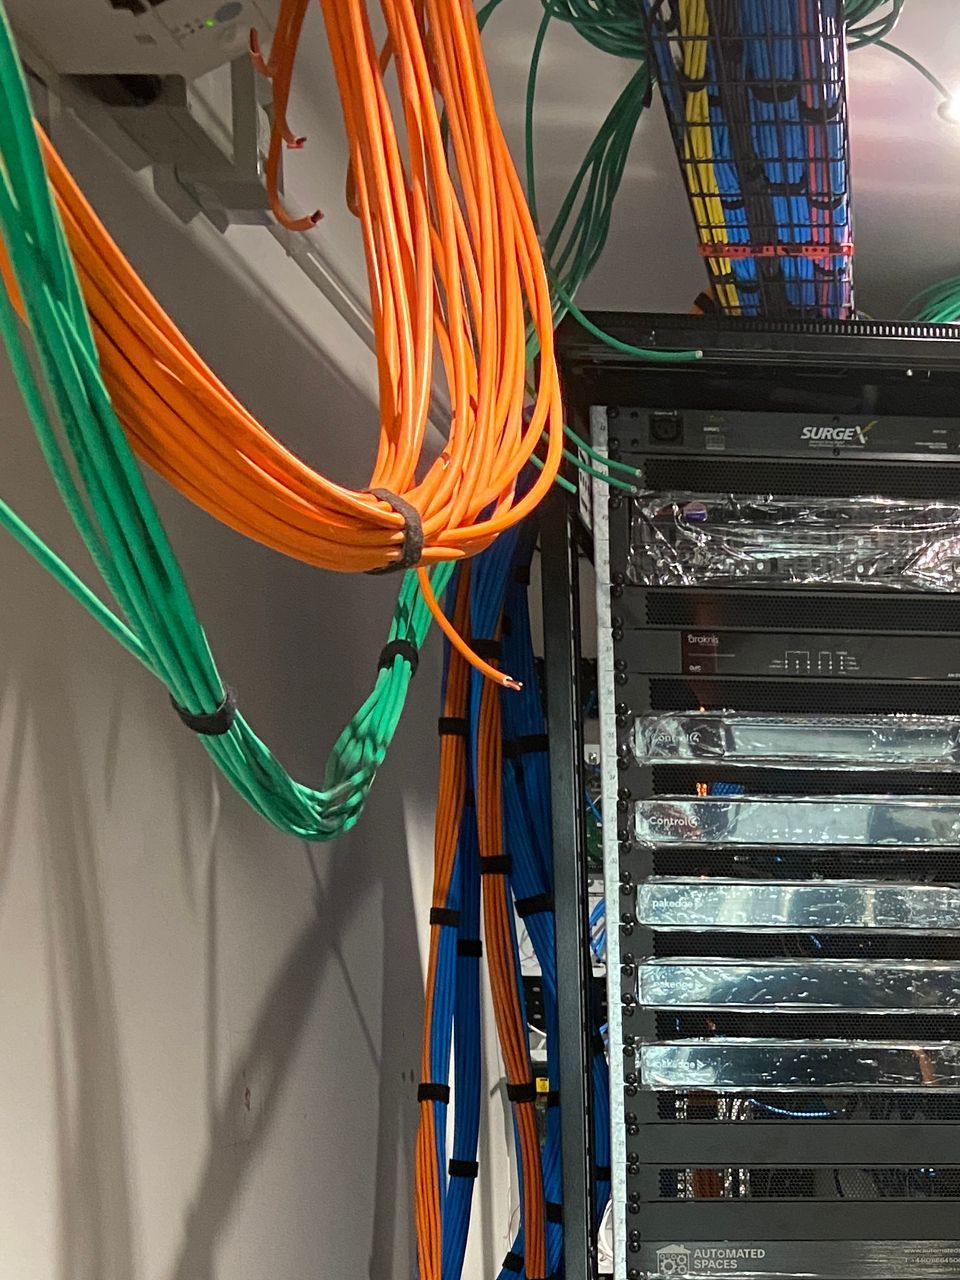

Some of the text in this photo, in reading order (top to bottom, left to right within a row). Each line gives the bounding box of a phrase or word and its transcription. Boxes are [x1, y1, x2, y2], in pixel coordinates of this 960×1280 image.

[800, 421, 878, 444] SURGEX
[693, 1248, 766, 1259] AUTOMATED
[693, 1259, 738, 1269] SPACES
